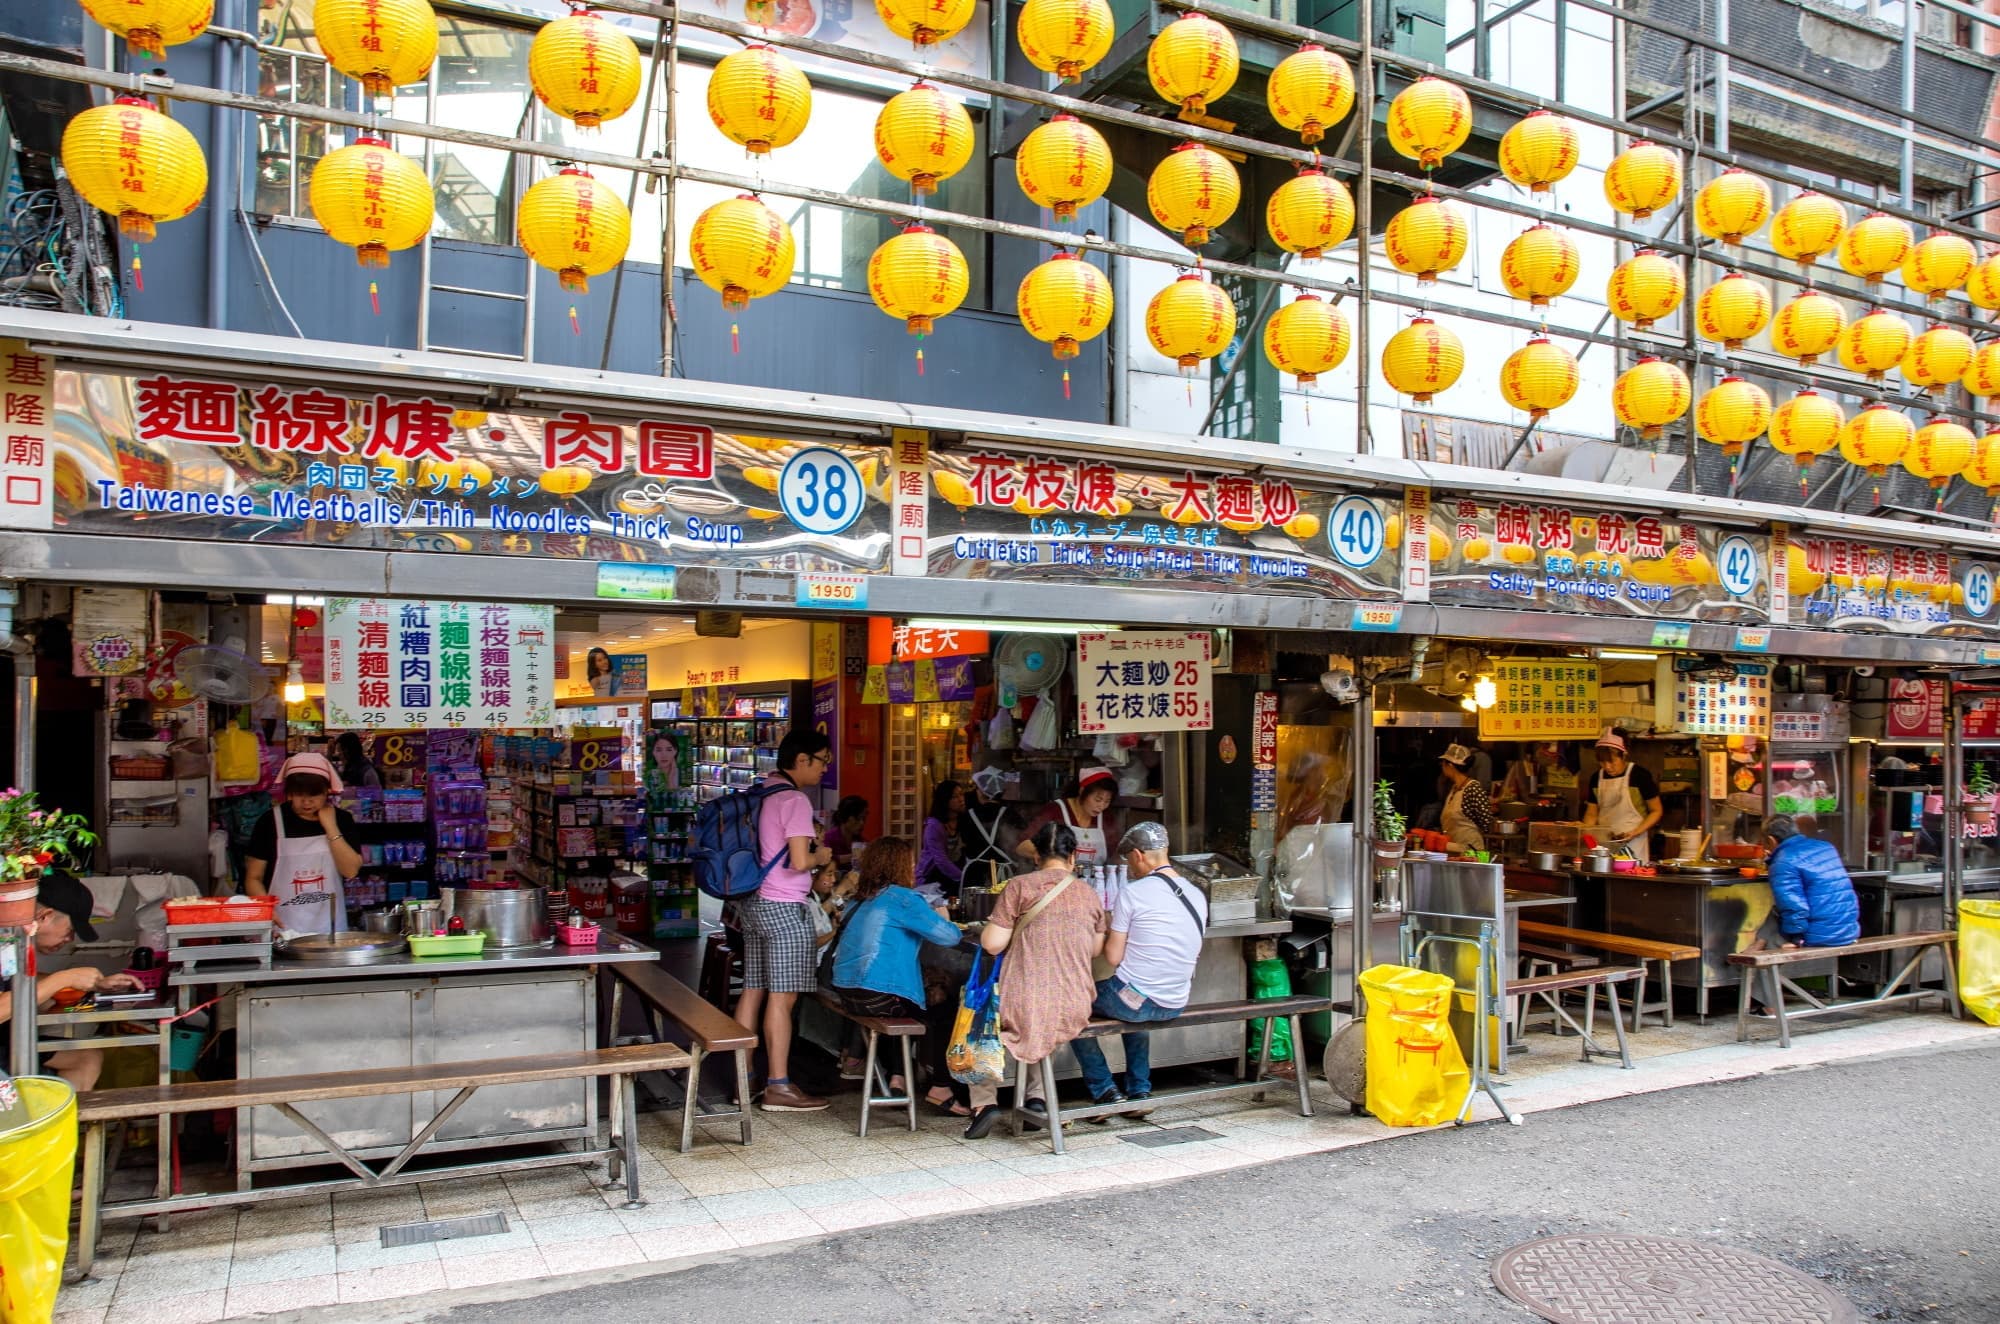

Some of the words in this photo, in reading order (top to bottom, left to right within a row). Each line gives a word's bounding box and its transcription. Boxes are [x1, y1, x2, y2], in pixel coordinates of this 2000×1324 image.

[4, 352, 45, 506] 基隆廟口
[795, 462, 847, 519] 38
[899, 439, 924, 558] 基隆廟口
[98, 480, 253, 515] Taiwanese
[492, 505, 591, 536] Noodles
[608, 513, 670, 541] Thick
[687, 516, 743, 549] Soup
[1340, 508, 1373, 556] 40
[1408, 488, 1426, 587] 基隆廟口
[954, 536, 1039, 563] Cuttlefish
[1050, 542, 1093, 566] Thick
[1203, 552, 1242, 574] Thick
[1250, 555, 1308, 578] Noodles
[1727, 547, 1750, 585] 42
[814, 584, 852, 599] 1950
[1489, 570, 1536, 596] Salty
[1970, 573, 1988, 607] 46
[1364, 611, 1391, 624] 1950
[400, 603, 432, 708] 紅糟肉圓
[1132, 637, 1185, 650] 六十年老店
[357, 620, 391, 708] 清麵線
[1095, 660, 1170, 687] 大麵炒
[1174, 660, 1199, 686] 25
[362, 711, 386, 723] 25
[404, 711, 427, 723] 35
[442, 711, 466, 722] 45
[485, 711, 508, 722] 45
[1174, 692, 1199, 717] 55
[1261, 695, 1278, 748] 滅火器
